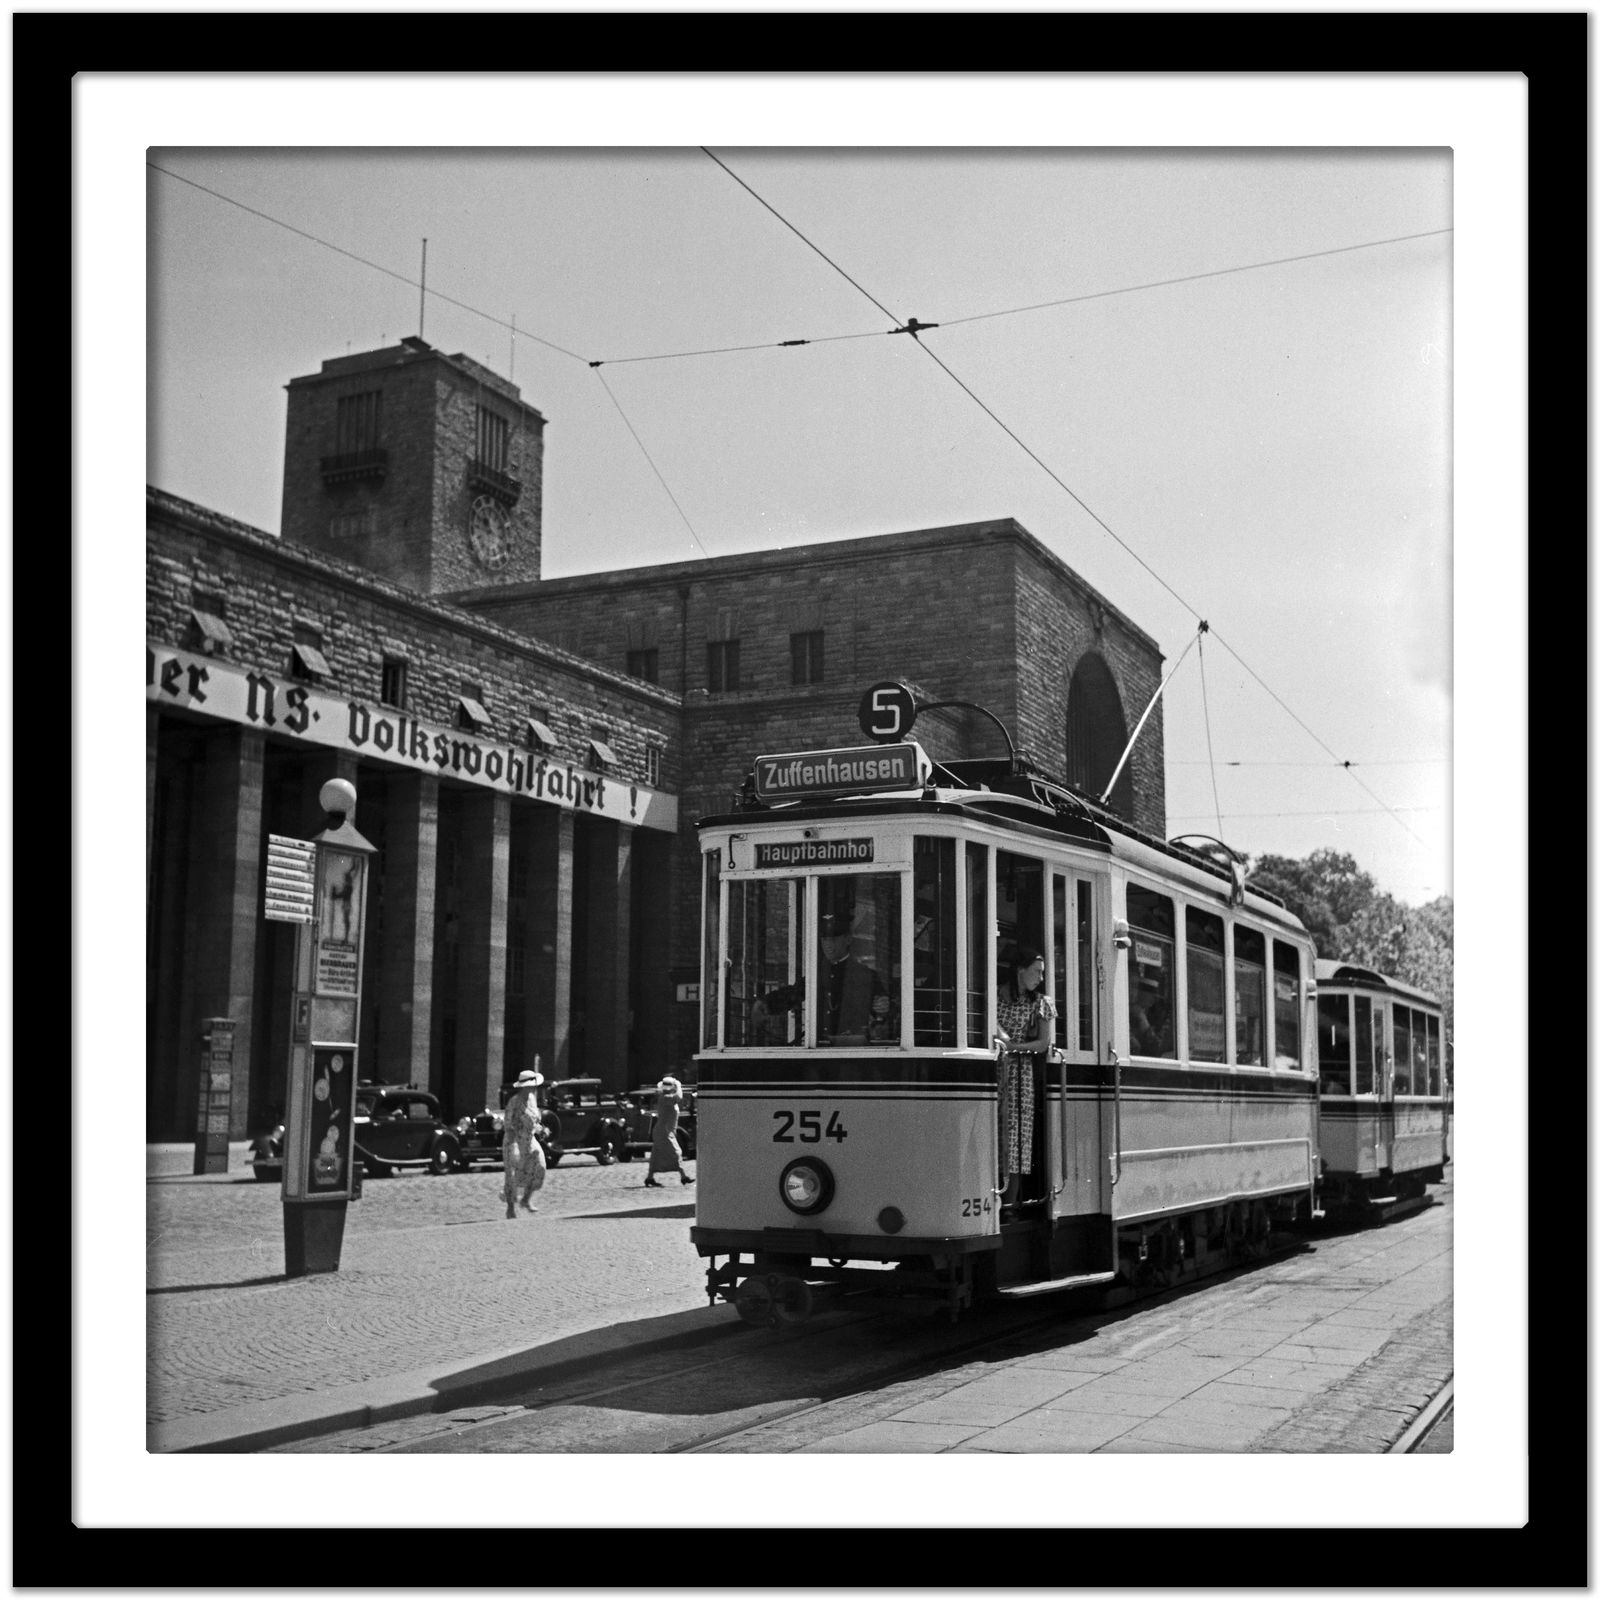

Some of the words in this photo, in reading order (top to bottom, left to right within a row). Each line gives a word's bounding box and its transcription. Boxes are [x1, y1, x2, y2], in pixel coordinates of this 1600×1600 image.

[871, 688, 900, 735] 5
[347, 701, 606, 810] Volkswohlfahrt
[764, 757, 905, 789] Zuffenhausen
[762, 840, 873, 864] Hauptbahnhof
[772, 1110, 848, 1143] 254
[961, 1198, 992, 1217] 254
